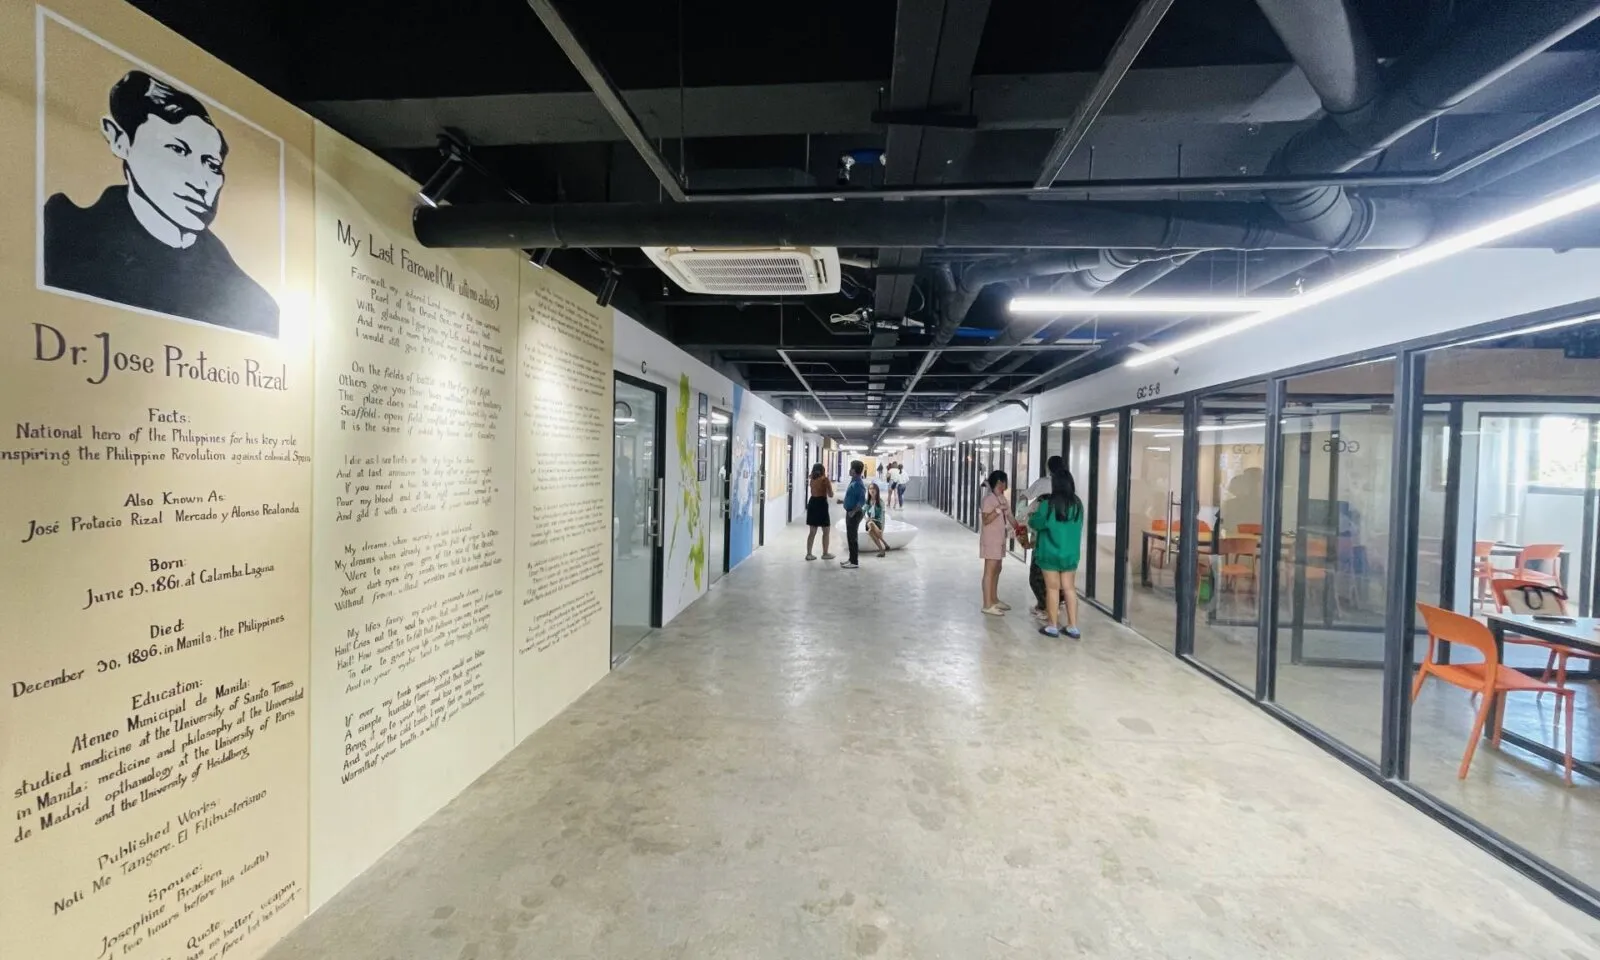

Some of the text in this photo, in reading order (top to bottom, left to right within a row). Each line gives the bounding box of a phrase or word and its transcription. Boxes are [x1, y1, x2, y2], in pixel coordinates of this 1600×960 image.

[338, 219, 361, 257] My
[369, 233, 394, 265] Last
[357, 314, 373, 328] And
[32, 322, 289, 391] Dr. Jose Protacio Rizal
[352, 360, 404, 381] On the fields
[641, 361, 648, 374] C
[338, 374, 406, 397] Others you
[1136, 386, 1148, 399] GC
[338, 389, 404, 408] The place does
[148, 408, 191, 424] Facts:
[384, 413, 403, 425] open
[16, 422, 297, 449] National hero of the Philippines for his key role
[365, 422, 377, 432] the
[78, 446, 100, 461] the
[106, 446, 165, 465] Philippine
[171, 447, 226, 462] Revolution
[231, 450, 262, 464] against
[264, 450, 291, 462] colonial
[1232, 443, 1252, 455] GC
[336, 468, 382, 478] And last
[355, 480, 392, 495] you need
[124, 493, 154, 508] Also
[162, 491, 204, 506] Known
[336, 493, 393, 508] Pour my blood
[21, 520, 59, 542] José
[71, 513, 122, 532] Protacio
[130, 511, 163, 526] Rizal
[174, 507, 218, 523] Mercado
[221, 512, 229, 524] y
[231, 505, 260, 519] Alonso
[336, 509, 352, 522] And
[344, 543, 357, 556] My
[149, 558, 187, 573] Born:
[335, 557, 376, 572] My dreams
[345, 570, 367, 582] Were
[82, 587, 124, 610] June
[185, 571, 195, 587] at
[340, 586, 357, 598] Your
[334, 595, 364, 611] Without
[150, 619, 185, 639] Died:
[347, 628, 360, 640] My
[12, 669, 85, 698] December
[163, 643, 174, 655] in
[219, 625, 235, 640] the
[238, 613, 285, 634] Philippines
[345, 668, 392, 694] And your
[131, 678, 203, 710] Education:
[71, 678, 250, 754] Ateneo Municipal de Manila:
[359, 698, 393, 719] ever my
[344, 699, 412, 742] A simple humble
[14, 680, 294, 799] studied medicine at the University of Santo Tomas
[345, 711, 415, 755] Bring your
[16, 806, 32, 820] in
[36, 782, 88, 812] Manila:
[98, 756, 151, 785] medicine
[156, 742, 176, 759] and
[181, 721, 233, 752] philosophy
[236, 711, 246, 726] at
[250, 704, 262, 719] the
[343, 740, 385, 771] And under
[381, 747, 397, 765] your
[14, 829, 32, 844] de
[40, 796, 90, 831] Madrid
[178, 753, 188, 768] at
[194, 742, 209, 758] the
[215, 726, 254, 750] University
[259, 717, 270, 733] of
[275, 708, 295, 724] Paris
[94, 807, 115, 825] and
[121, 796, 137, 811] the
[140, 773, 187, 803] University
[191, 763, 201, 782] of
[98, 821, 170, 870] Published
[53, 888, 84, 915] Noli
[92, 875, 112, 894] Me
[178, 829, 188, 844] El
[148, 862, 203, 903] Spouse:
[97, 868, 222, 959] Josephine Bracken
[147, 912, 180, 938] hours
[184, 888, 216, 913] before
[223, 911, 254, 937] better
